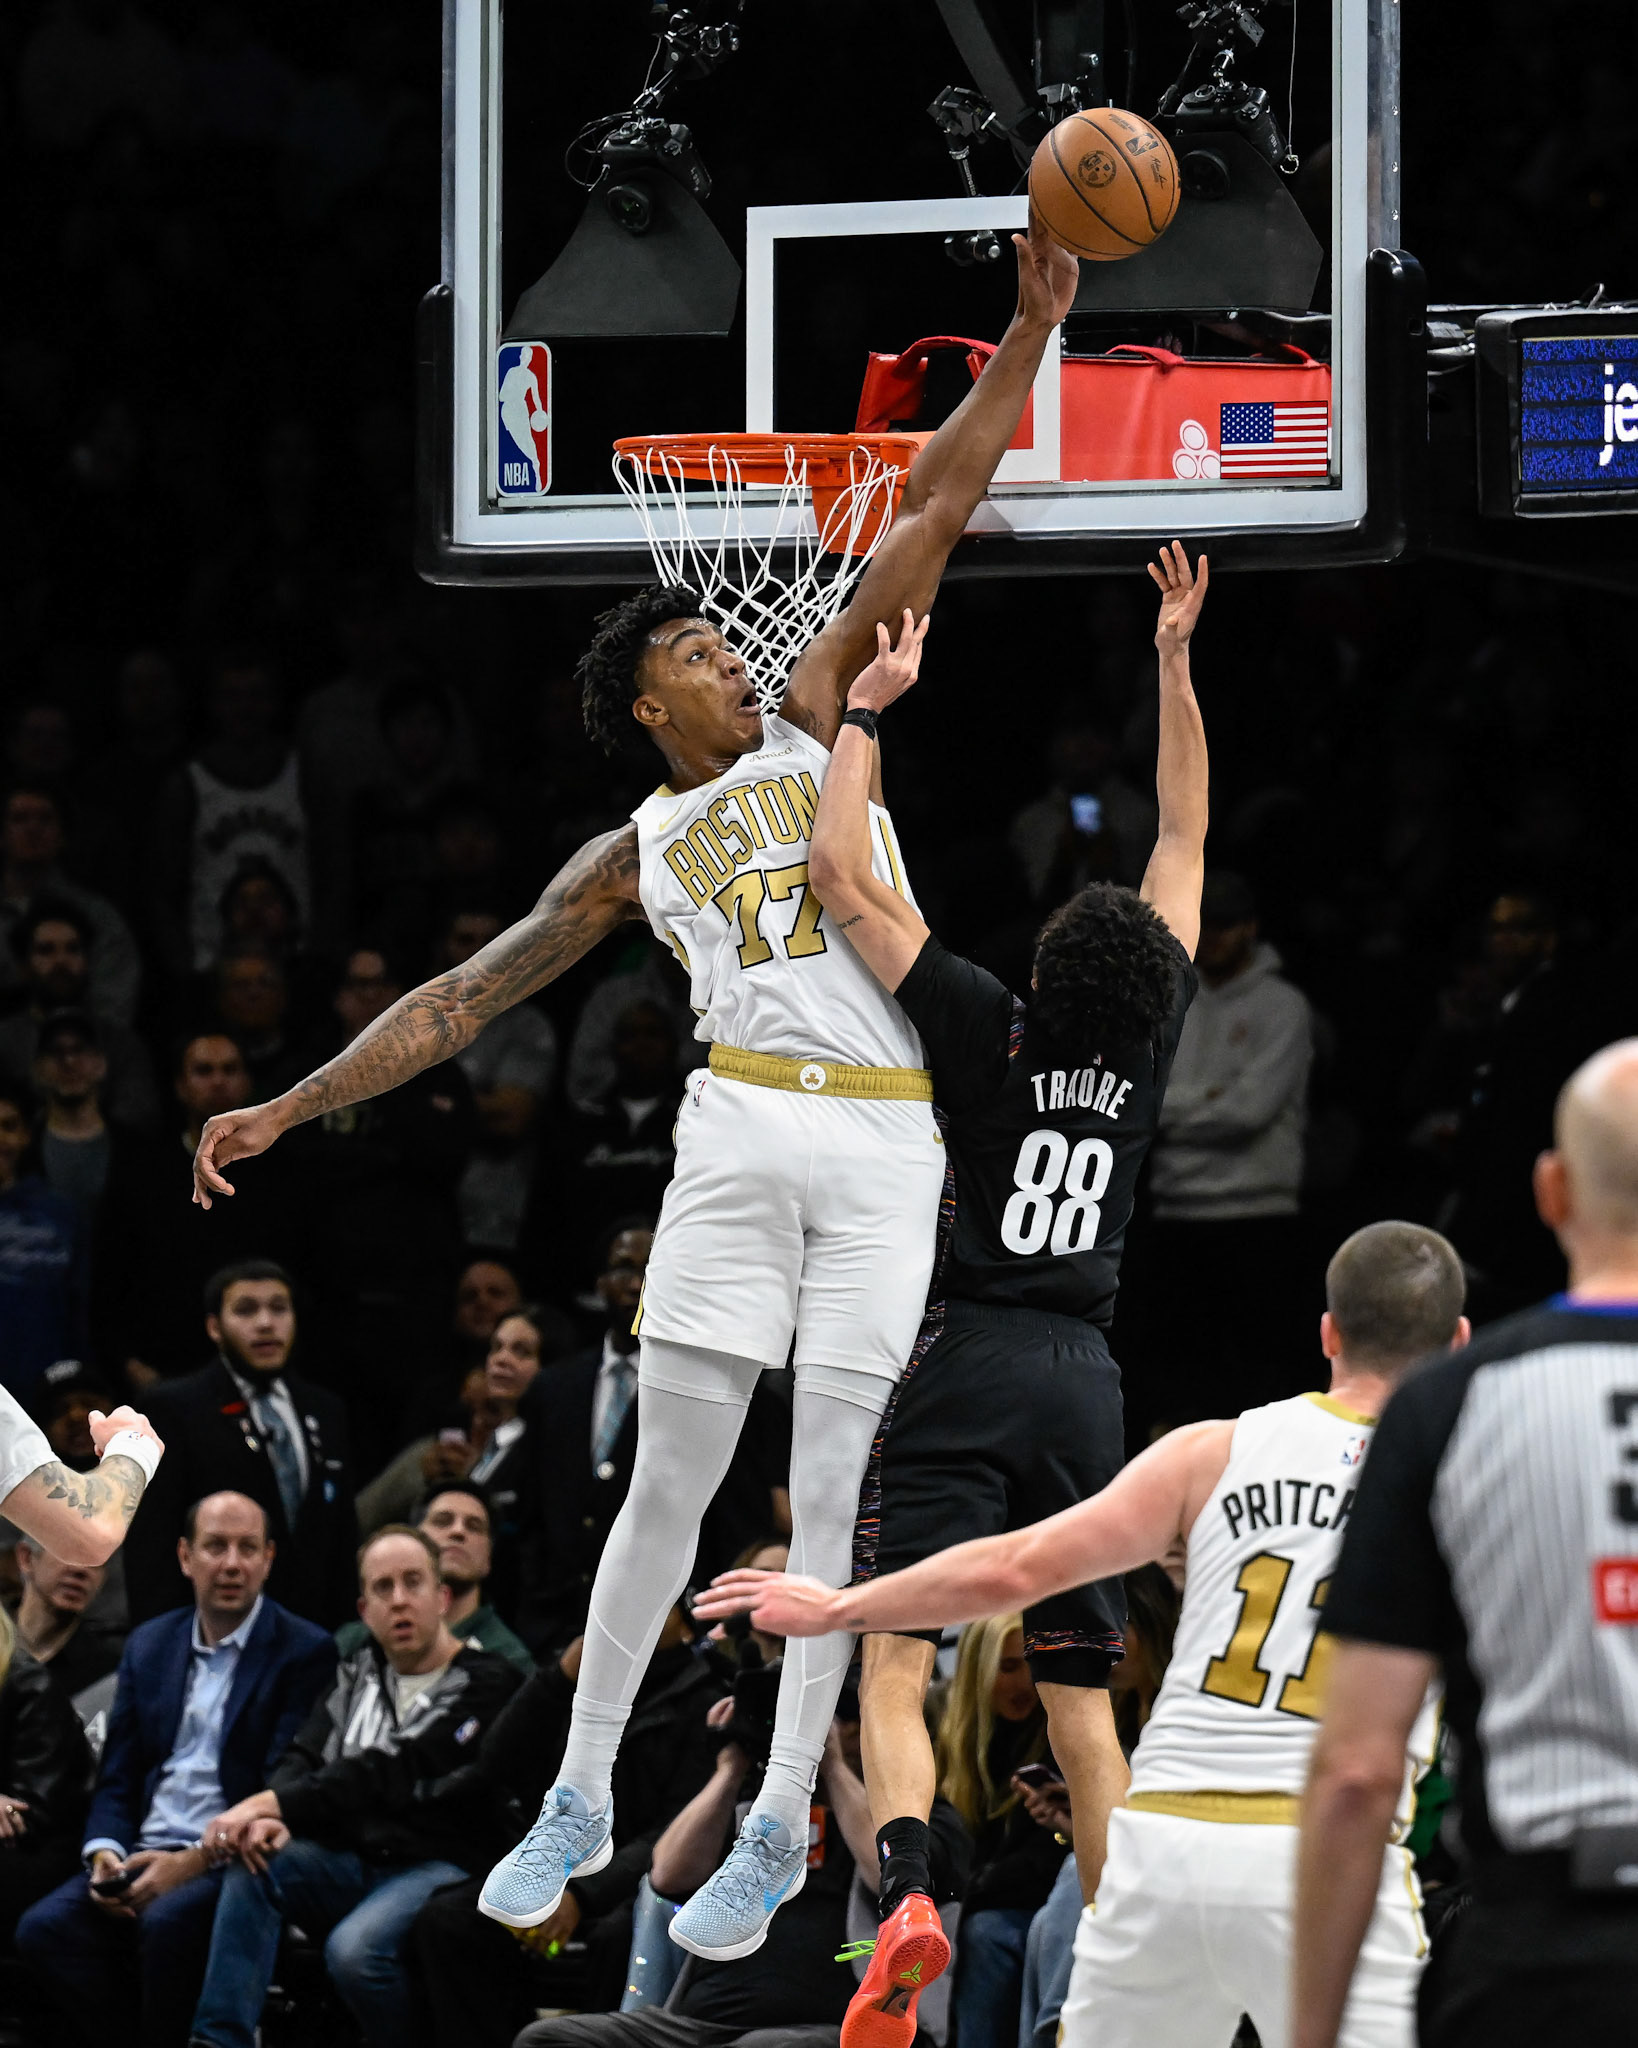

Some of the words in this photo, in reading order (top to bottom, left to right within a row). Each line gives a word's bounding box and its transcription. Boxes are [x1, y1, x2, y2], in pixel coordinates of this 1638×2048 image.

[1599, 362, 1638, 467] je
[503, 462, 530, 487] NBA
[749, 746, 794, 763] Amica
[663, 771, 820, 911] BOSTON
[711, 860, 828, 970] 77
[1030, 1067, 1134, 1120] TRAORE
[1001, 1129, 1114, 1257] 88
